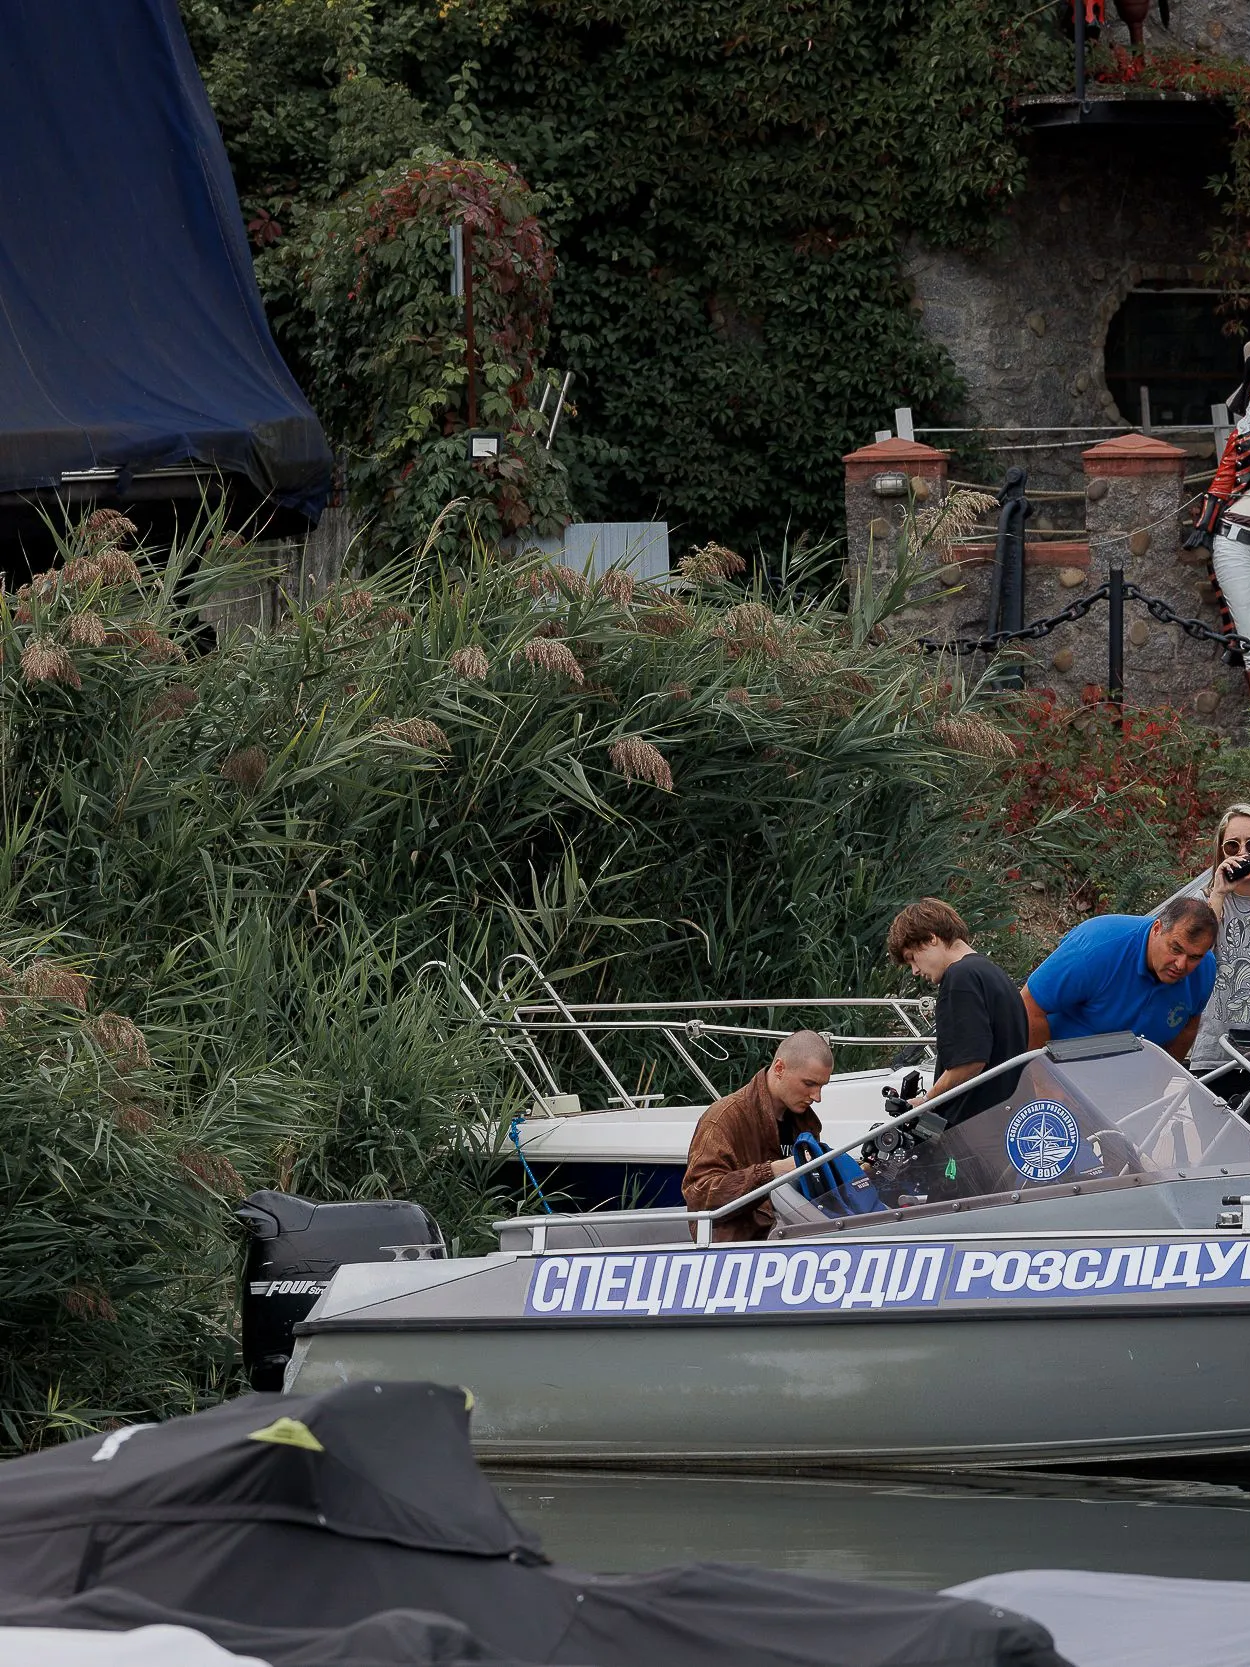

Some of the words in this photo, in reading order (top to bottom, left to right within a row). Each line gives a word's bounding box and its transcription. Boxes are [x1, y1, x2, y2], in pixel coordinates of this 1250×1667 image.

[1021, 1162, 1035, 1177] НА
[1037, 1164, 1062, 1178] ВОДІ
[532, 1247, 946, 1316] СПЕЦПІДРОЗДІЛ
